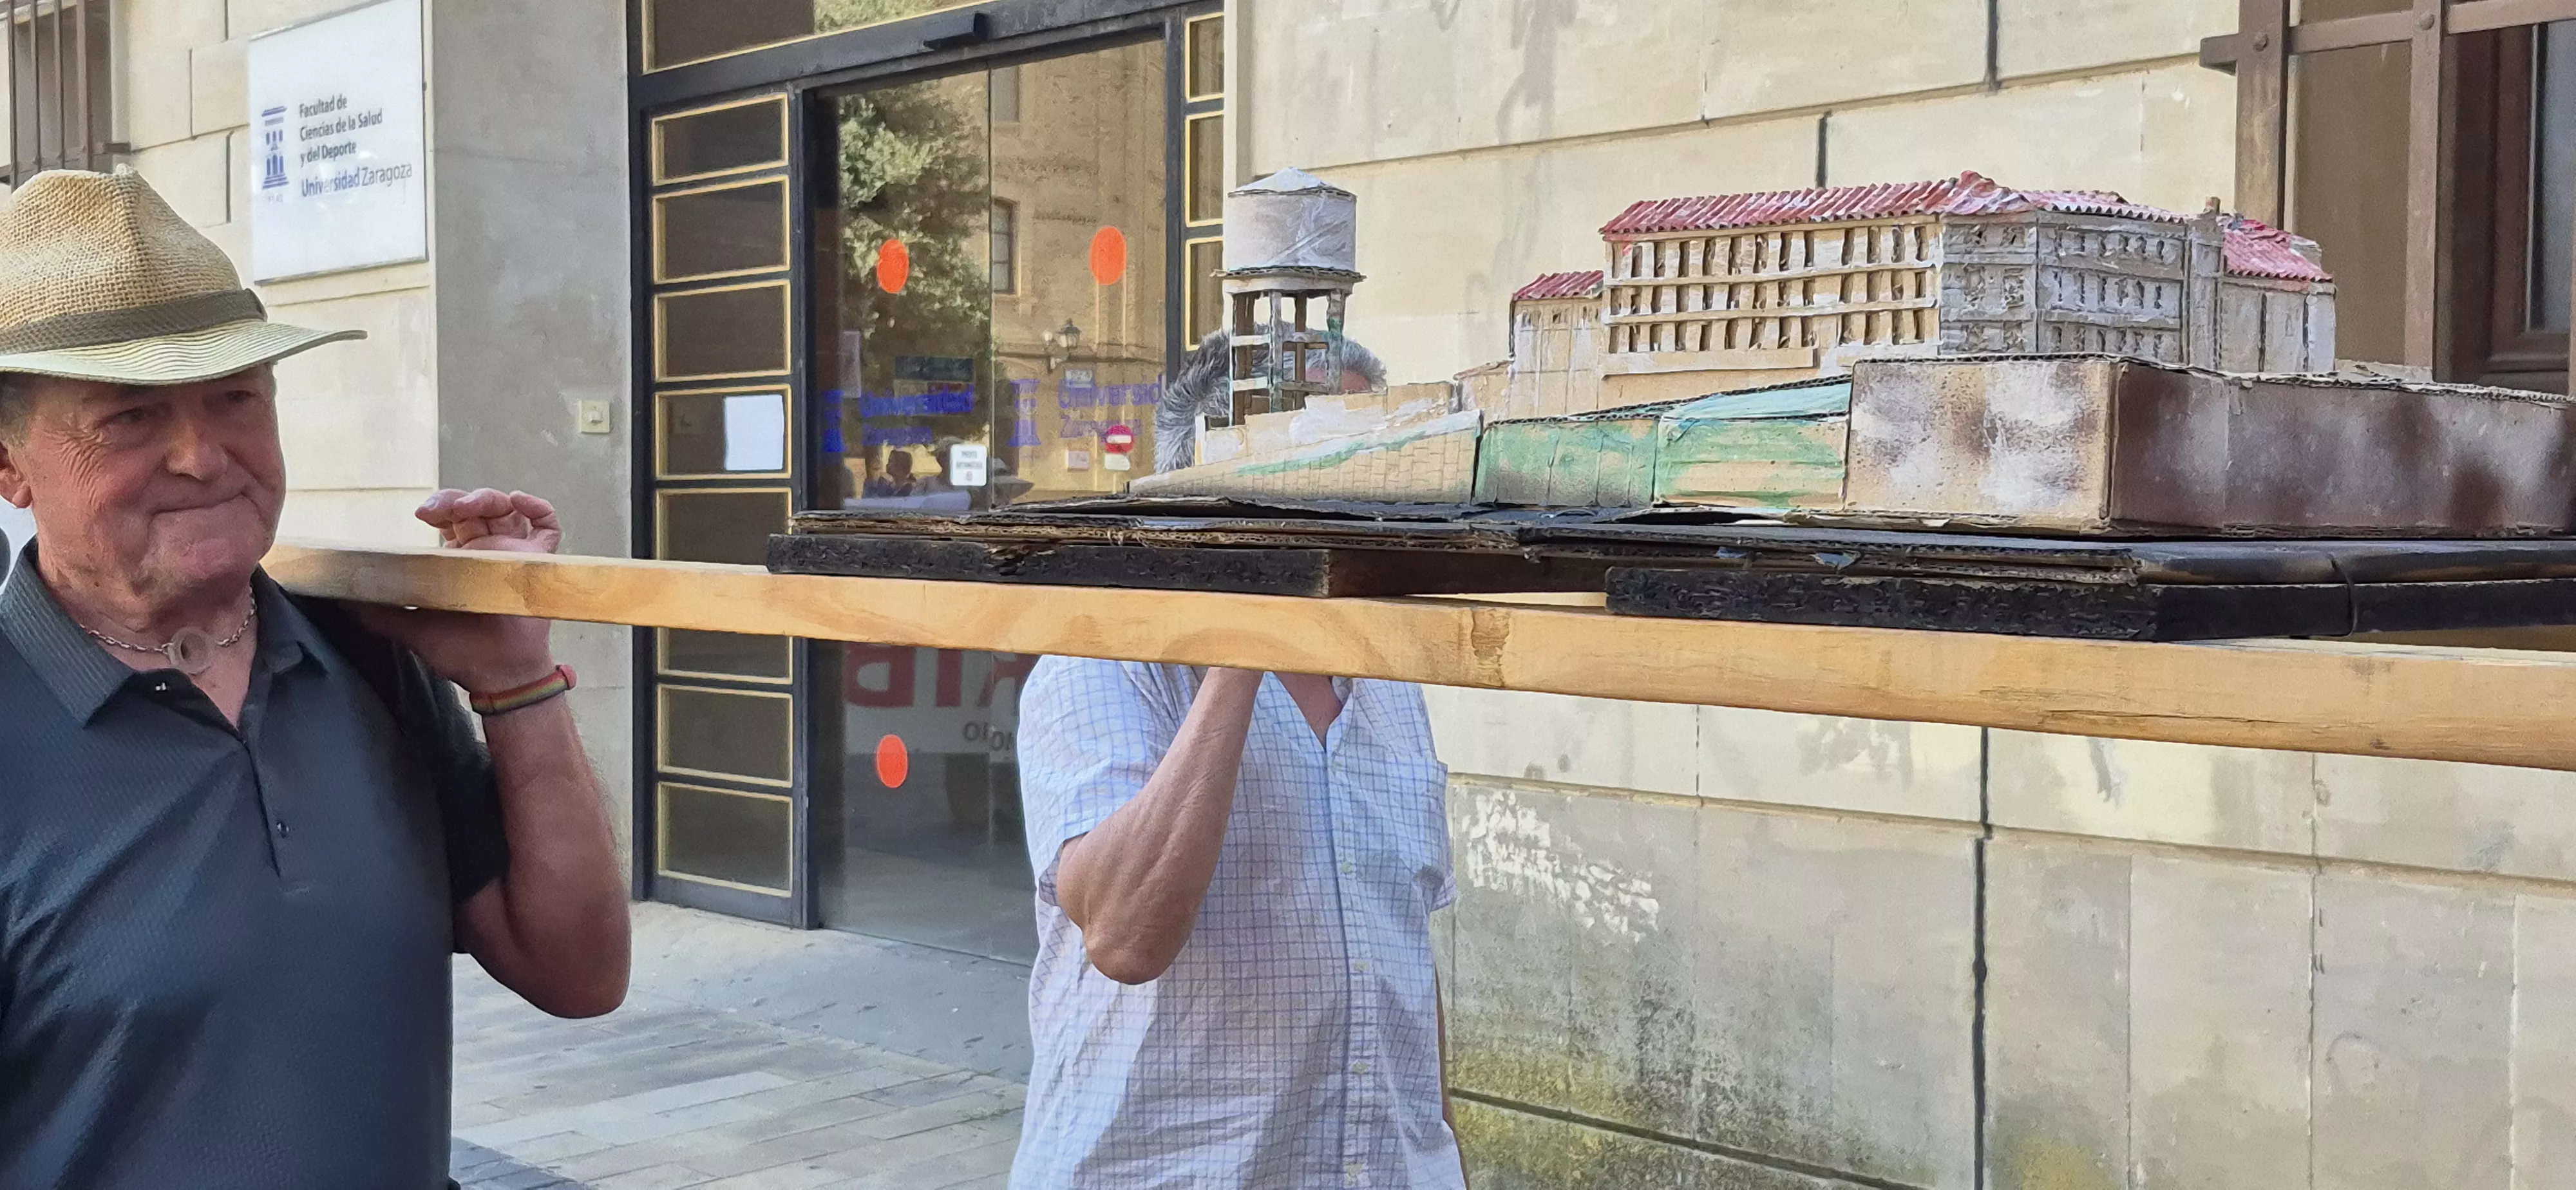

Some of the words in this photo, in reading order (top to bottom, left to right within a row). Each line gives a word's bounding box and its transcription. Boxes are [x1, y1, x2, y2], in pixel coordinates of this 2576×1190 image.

[299, 95, 334, 118] Facultad
[337, 93, 347, 110] de
[300, 120, 334, 141] Ciencias
[336, 116, 346, 133] de
[348, 115, 355, 131] la
[358, 108, 383, 129] Salud
[300, 153, 306, 168] y
[307, 145, 320, 162] del
[321, 140, 357, 162] Deporte
[301, 165, 361, 197] Universidad
[361, 162, 413, 187] Zaragoza
